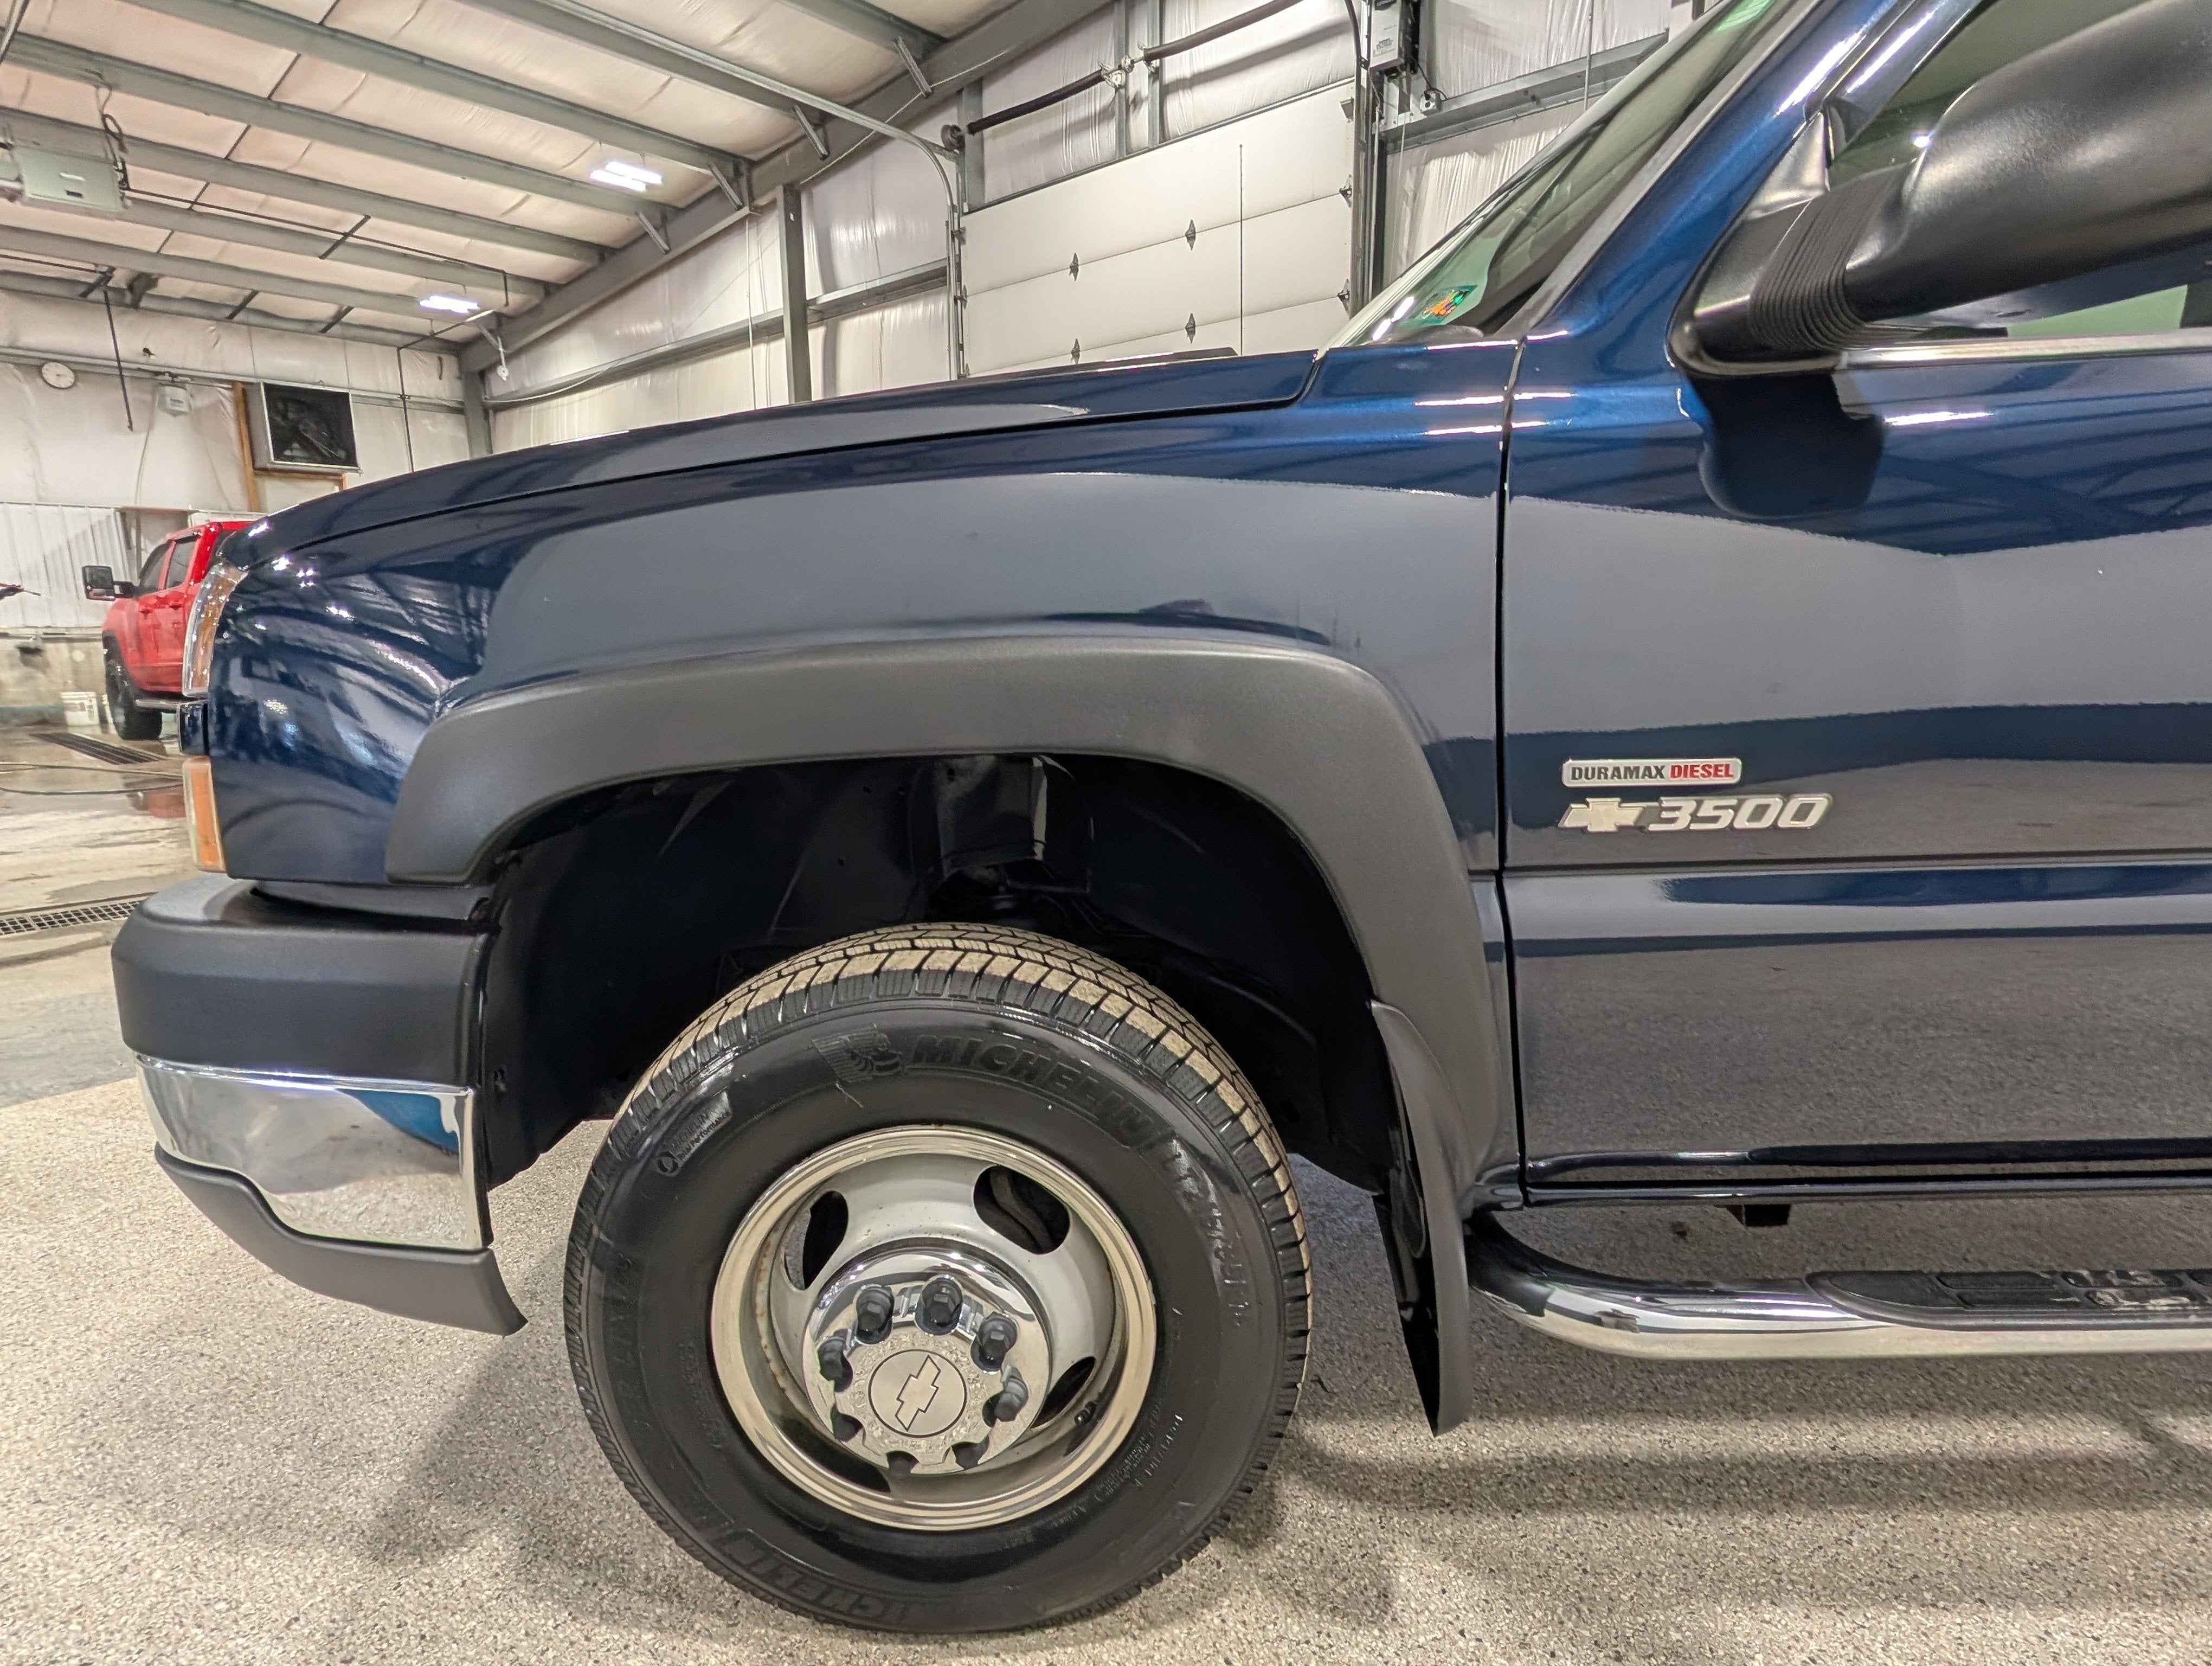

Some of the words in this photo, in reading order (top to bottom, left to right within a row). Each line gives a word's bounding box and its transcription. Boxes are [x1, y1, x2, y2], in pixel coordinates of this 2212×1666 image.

[1571, 764, 1666, 781] DURAMAX
[1670, 762, 1734, 779] DIESEL
[1646, 794, 1832, 830] 3500
[914, 1034, 1156, 1145] MICHELIN
